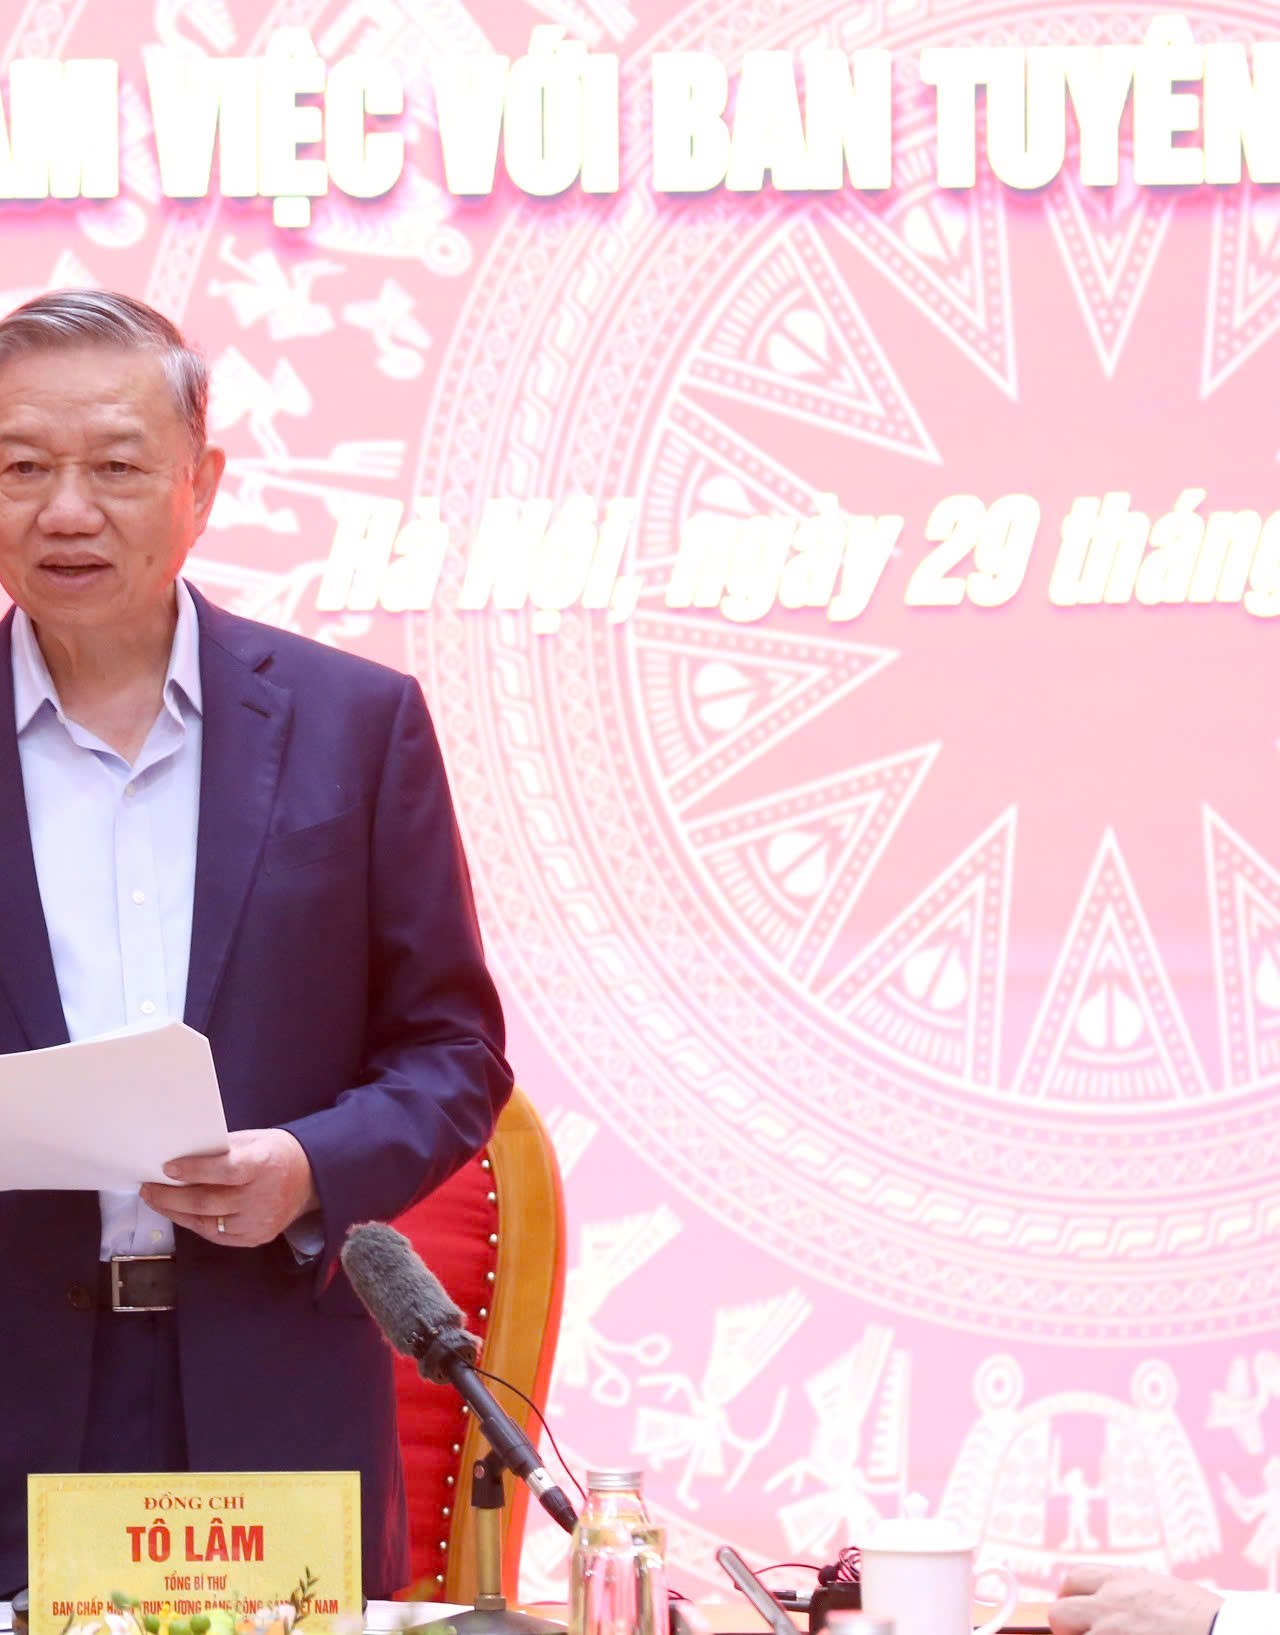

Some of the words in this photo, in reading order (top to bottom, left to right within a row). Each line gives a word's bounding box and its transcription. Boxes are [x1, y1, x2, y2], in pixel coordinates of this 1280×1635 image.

[144, 27, 405, 228] VIỆC
[432, 24, 619, 195] VỚI
[652, 50, 892, 192] BAN
[920, 15, 1280, 190] TUYÊN
[317, 497, 449, 612] Hà
[665, 493, 905, 621] ngày
[904, 494, 1041, 607] 29
[144, 1492, 202, 1510] ĐỒNG
[208, 1493, 245, 1510] CHÍ
[126, 1518, 170, 1562] TÔ
[185, 1517, 264, 1562] LÂM
[194, 1574, 204, 1591] BÍ
[207, 1574, 227, 1591] THƯ
[52, 1601, 74, 1616] BAN
[315, 1599, 339, 1614] NAM
